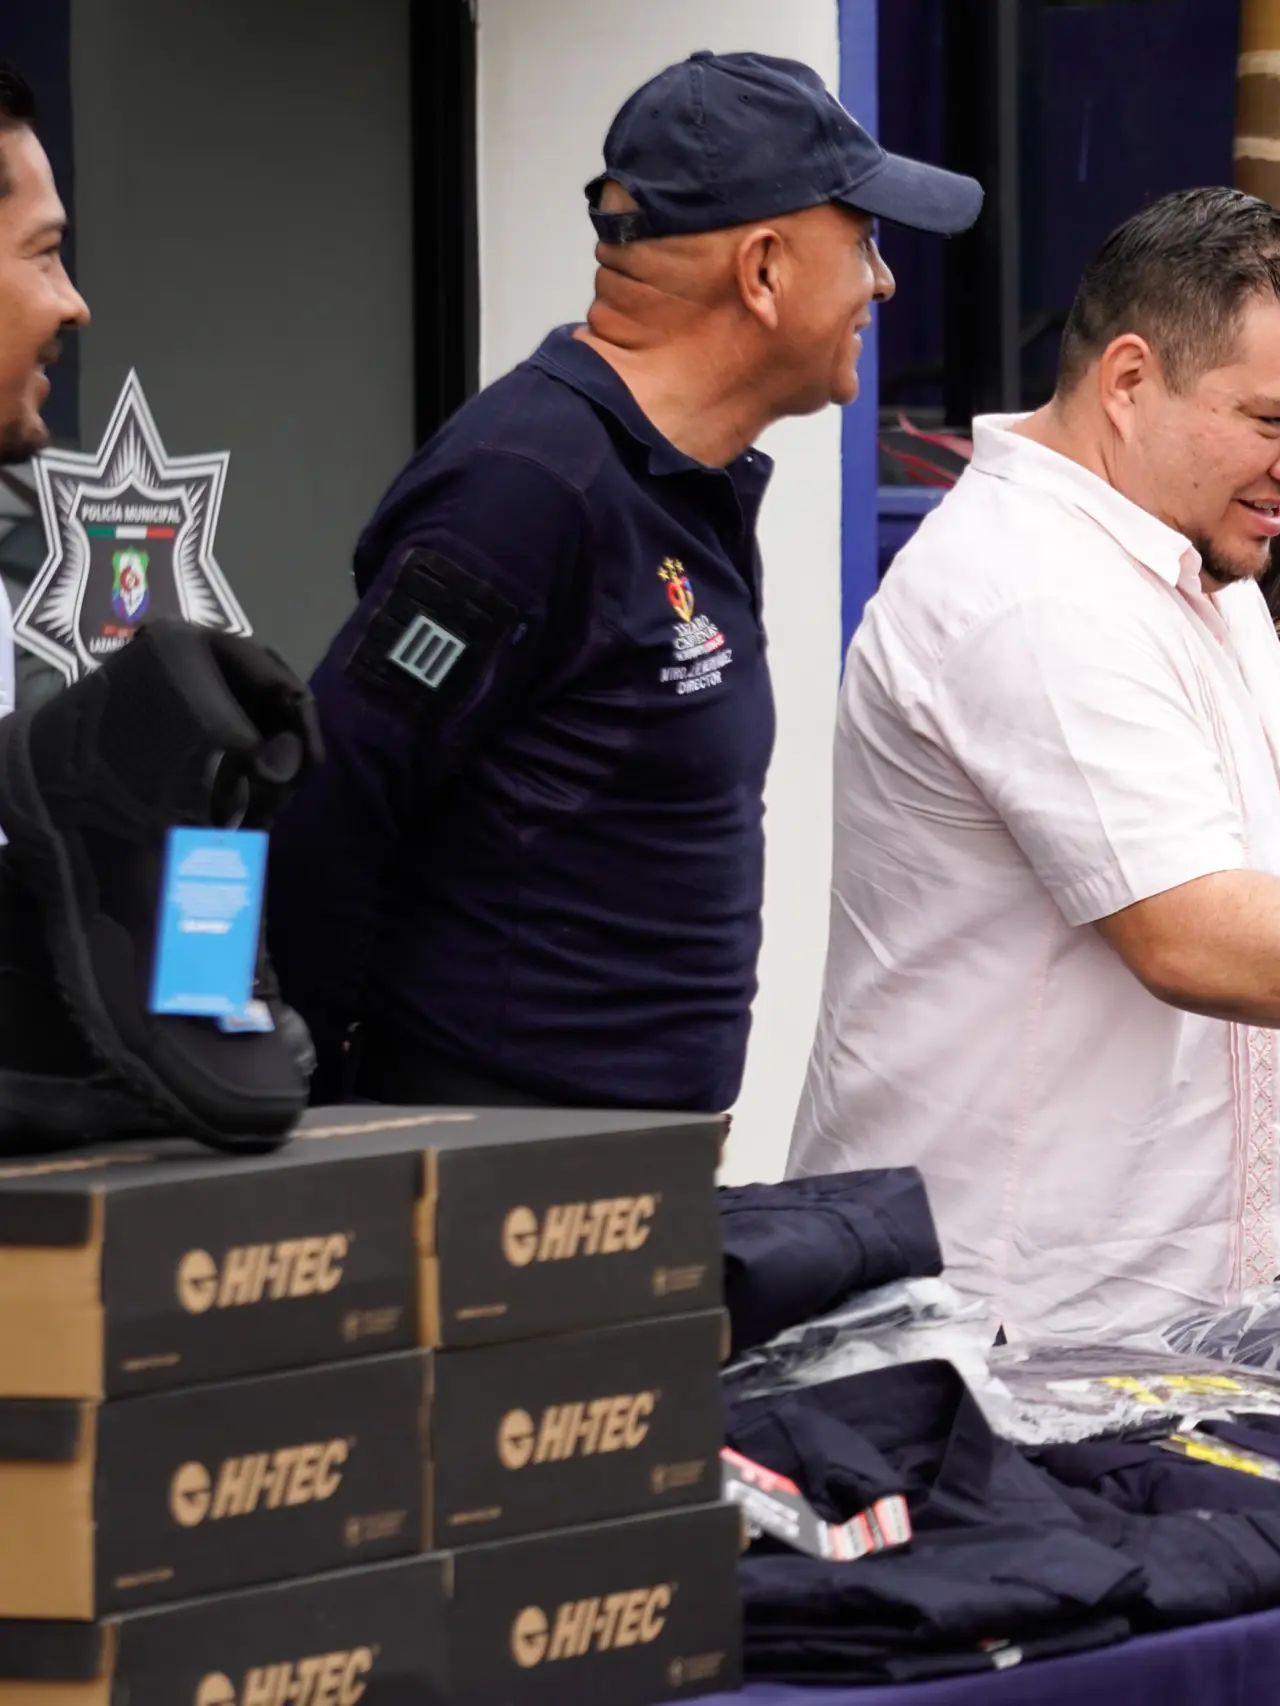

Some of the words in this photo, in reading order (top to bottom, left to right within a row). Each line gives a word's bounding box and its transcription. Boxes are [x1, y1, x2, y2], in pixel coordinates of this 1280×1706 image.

[81, 501, 122, 522] POLICÍA
[124, 504, 181, 524] MUNICIPAL
[534, 1196, 655, 1261] HI-TEC
[215, 1234, 348, 1307] HI-TEC
[534, 1392, 655, 1462] HI-TEC
[210, 1440, 349, 1519] HI-TEC
[546, 1586, 672, 1658] HI-TEC
